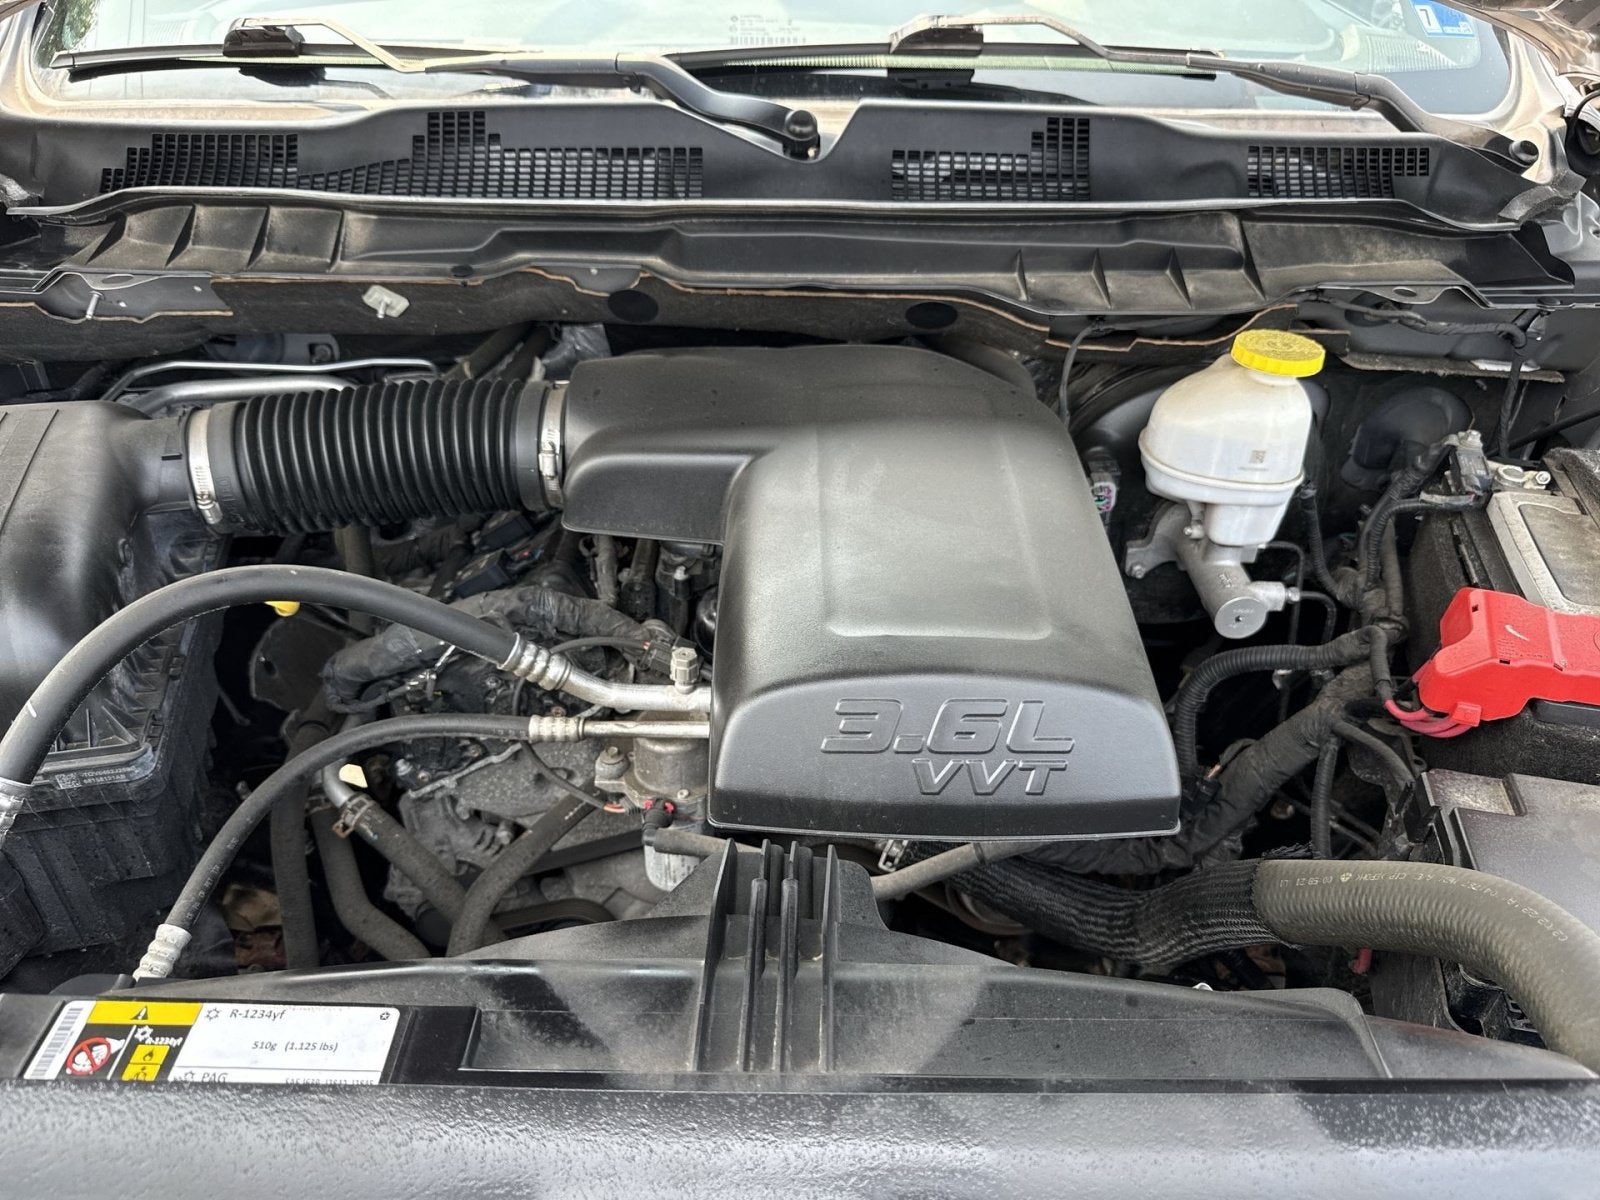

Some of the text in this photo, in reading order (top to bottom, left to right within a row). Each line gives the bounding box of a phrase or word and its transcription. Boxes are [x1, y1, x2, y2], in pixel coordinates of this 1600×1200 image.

[821, 698, 1075, 754] 3.6L
[912, 758, 1068, 796] VVT
[229, 1009, 286, 1022] R-1234yf
[252, 1041, 277, 1051] 510g
[285, 1041, 317, 1052] (1.125
[201, 1071, 229, 1083] PAG
